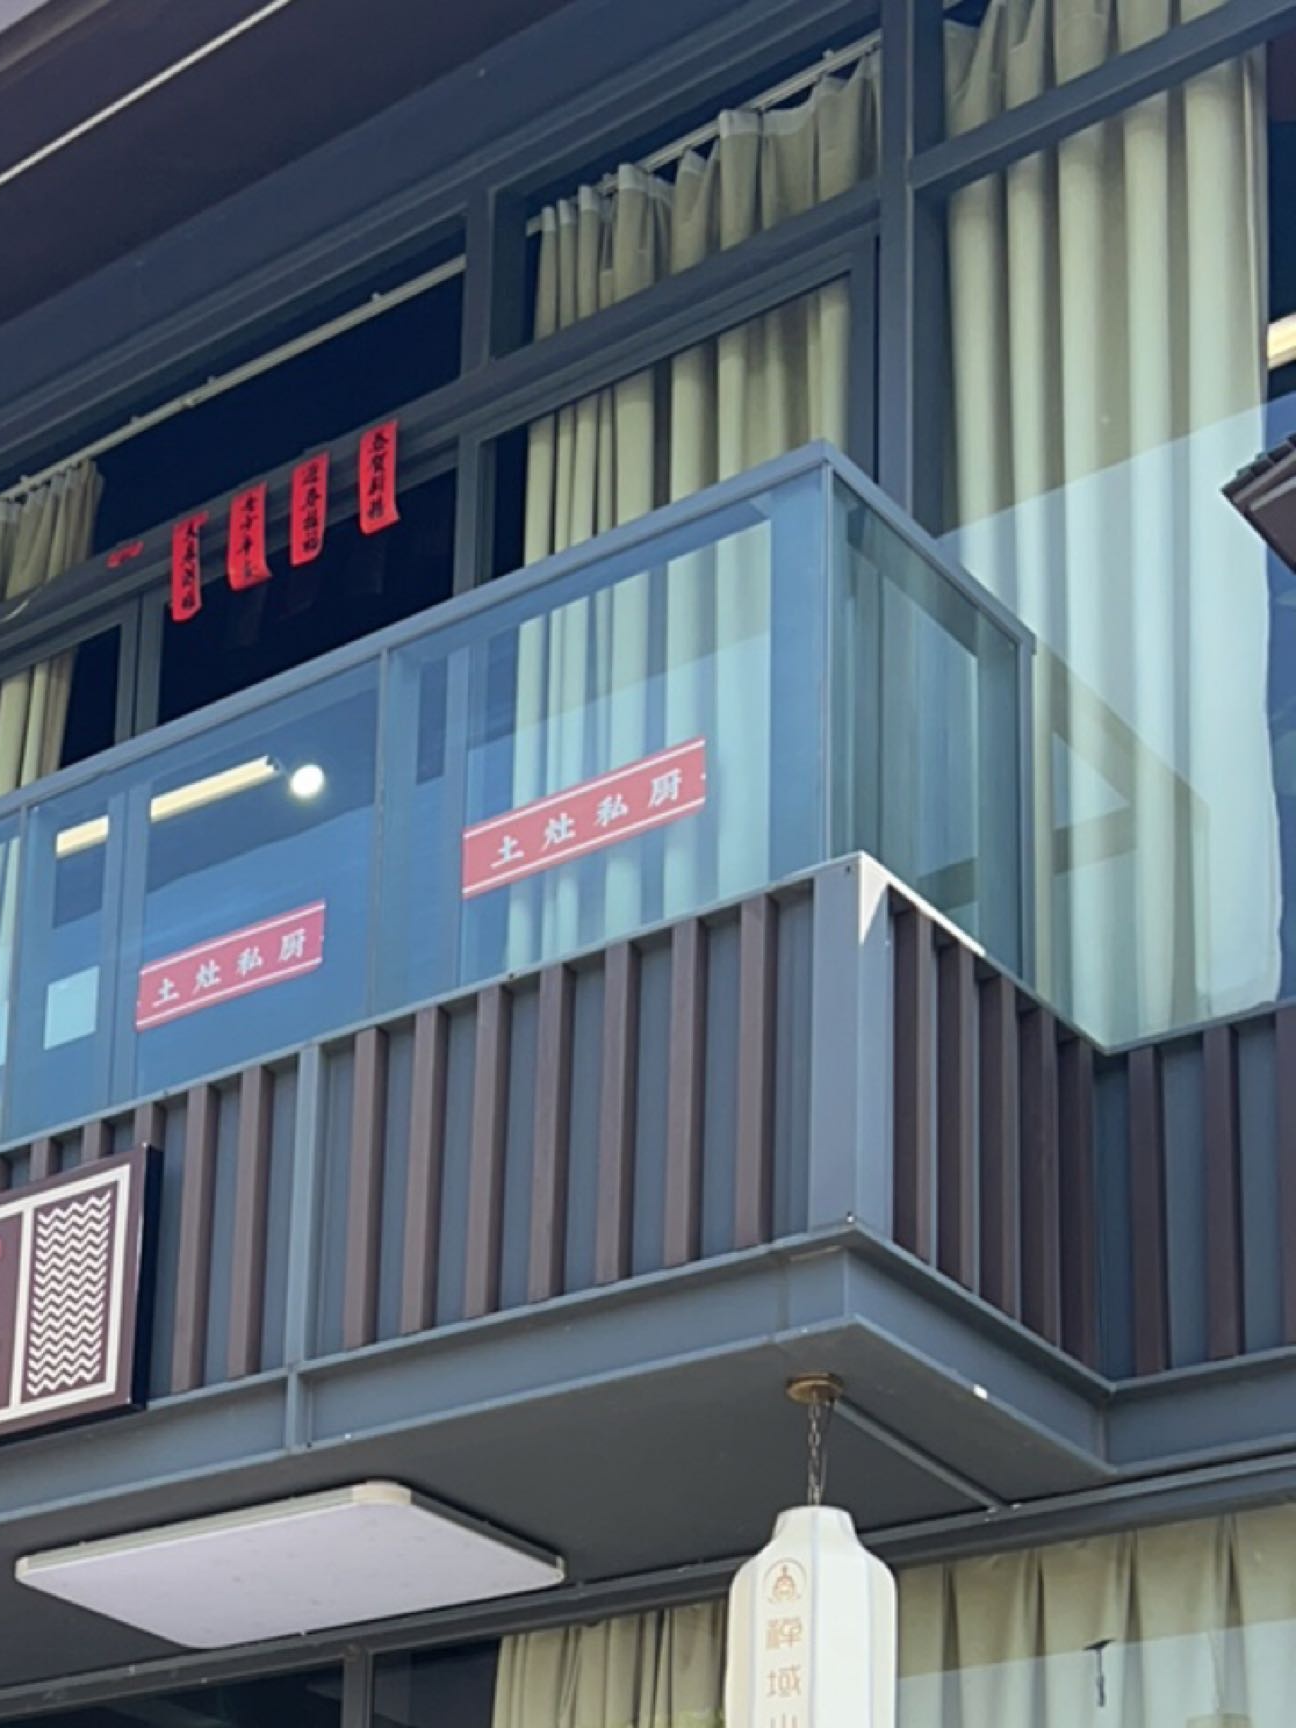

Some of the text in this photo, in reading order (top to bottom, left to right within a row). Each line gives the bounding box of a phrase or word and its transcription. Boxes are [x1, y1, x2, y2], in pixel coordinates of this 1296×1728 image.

[490, 768, 683, 870] 土灶私厨
[152, 927, 307, 1008] 土灶私厨
